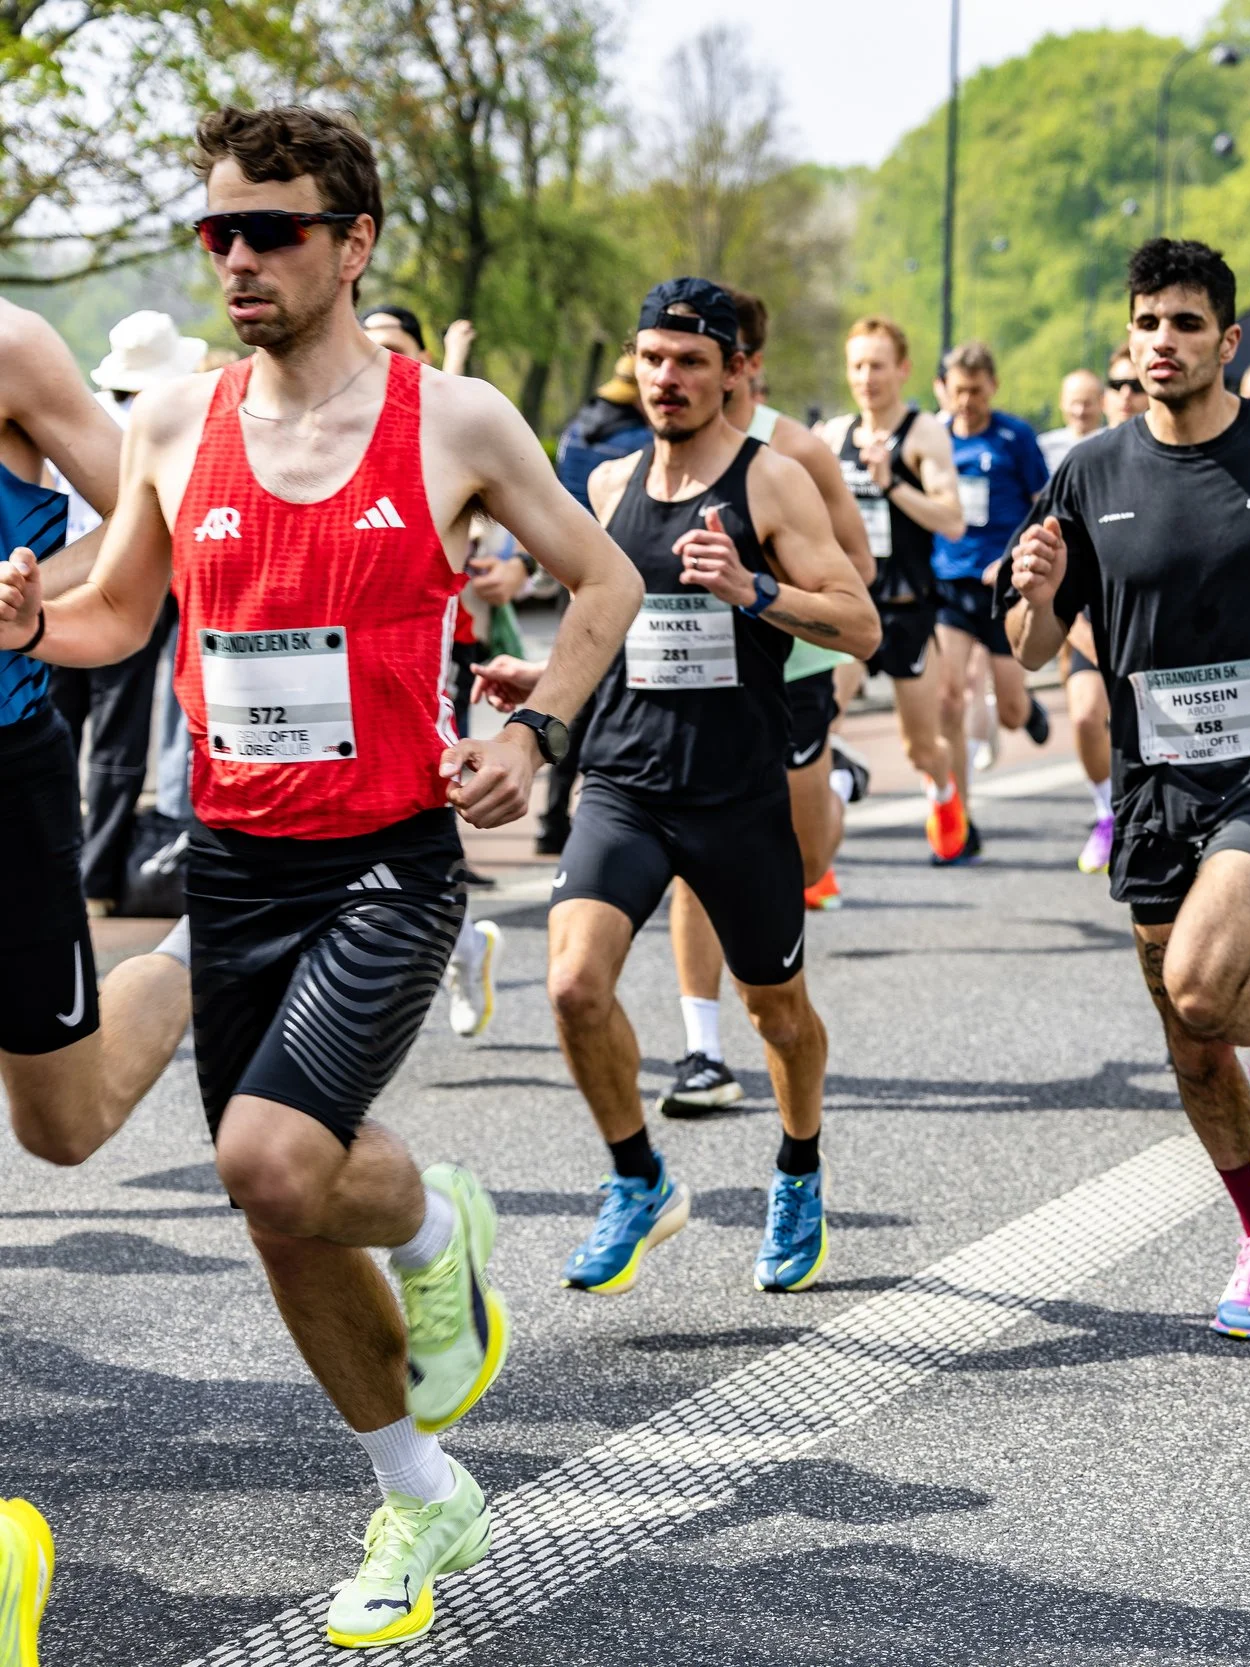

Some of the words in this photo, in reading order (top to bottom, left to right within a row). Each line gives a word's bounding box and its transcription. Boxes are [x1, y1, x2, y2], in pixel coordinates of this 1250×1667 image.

[649, 620, 702, 632] MIKKEL
[209, 633, 289, 653] RANDVEJEN
[291, 631, 313, 650] 5K
[662, 649, 689, 661] 281
[1153, 667, 1221, 687] STRANDVEJEN
[1224, 664, 1239, 679] 5K
[1172, 687, 1239, 707] HUSSEIN
[249, 706, 288, 725] 572
[1187, 703, 1226, 717] ABOUD
[1194, 719, 1224, 735] 458
